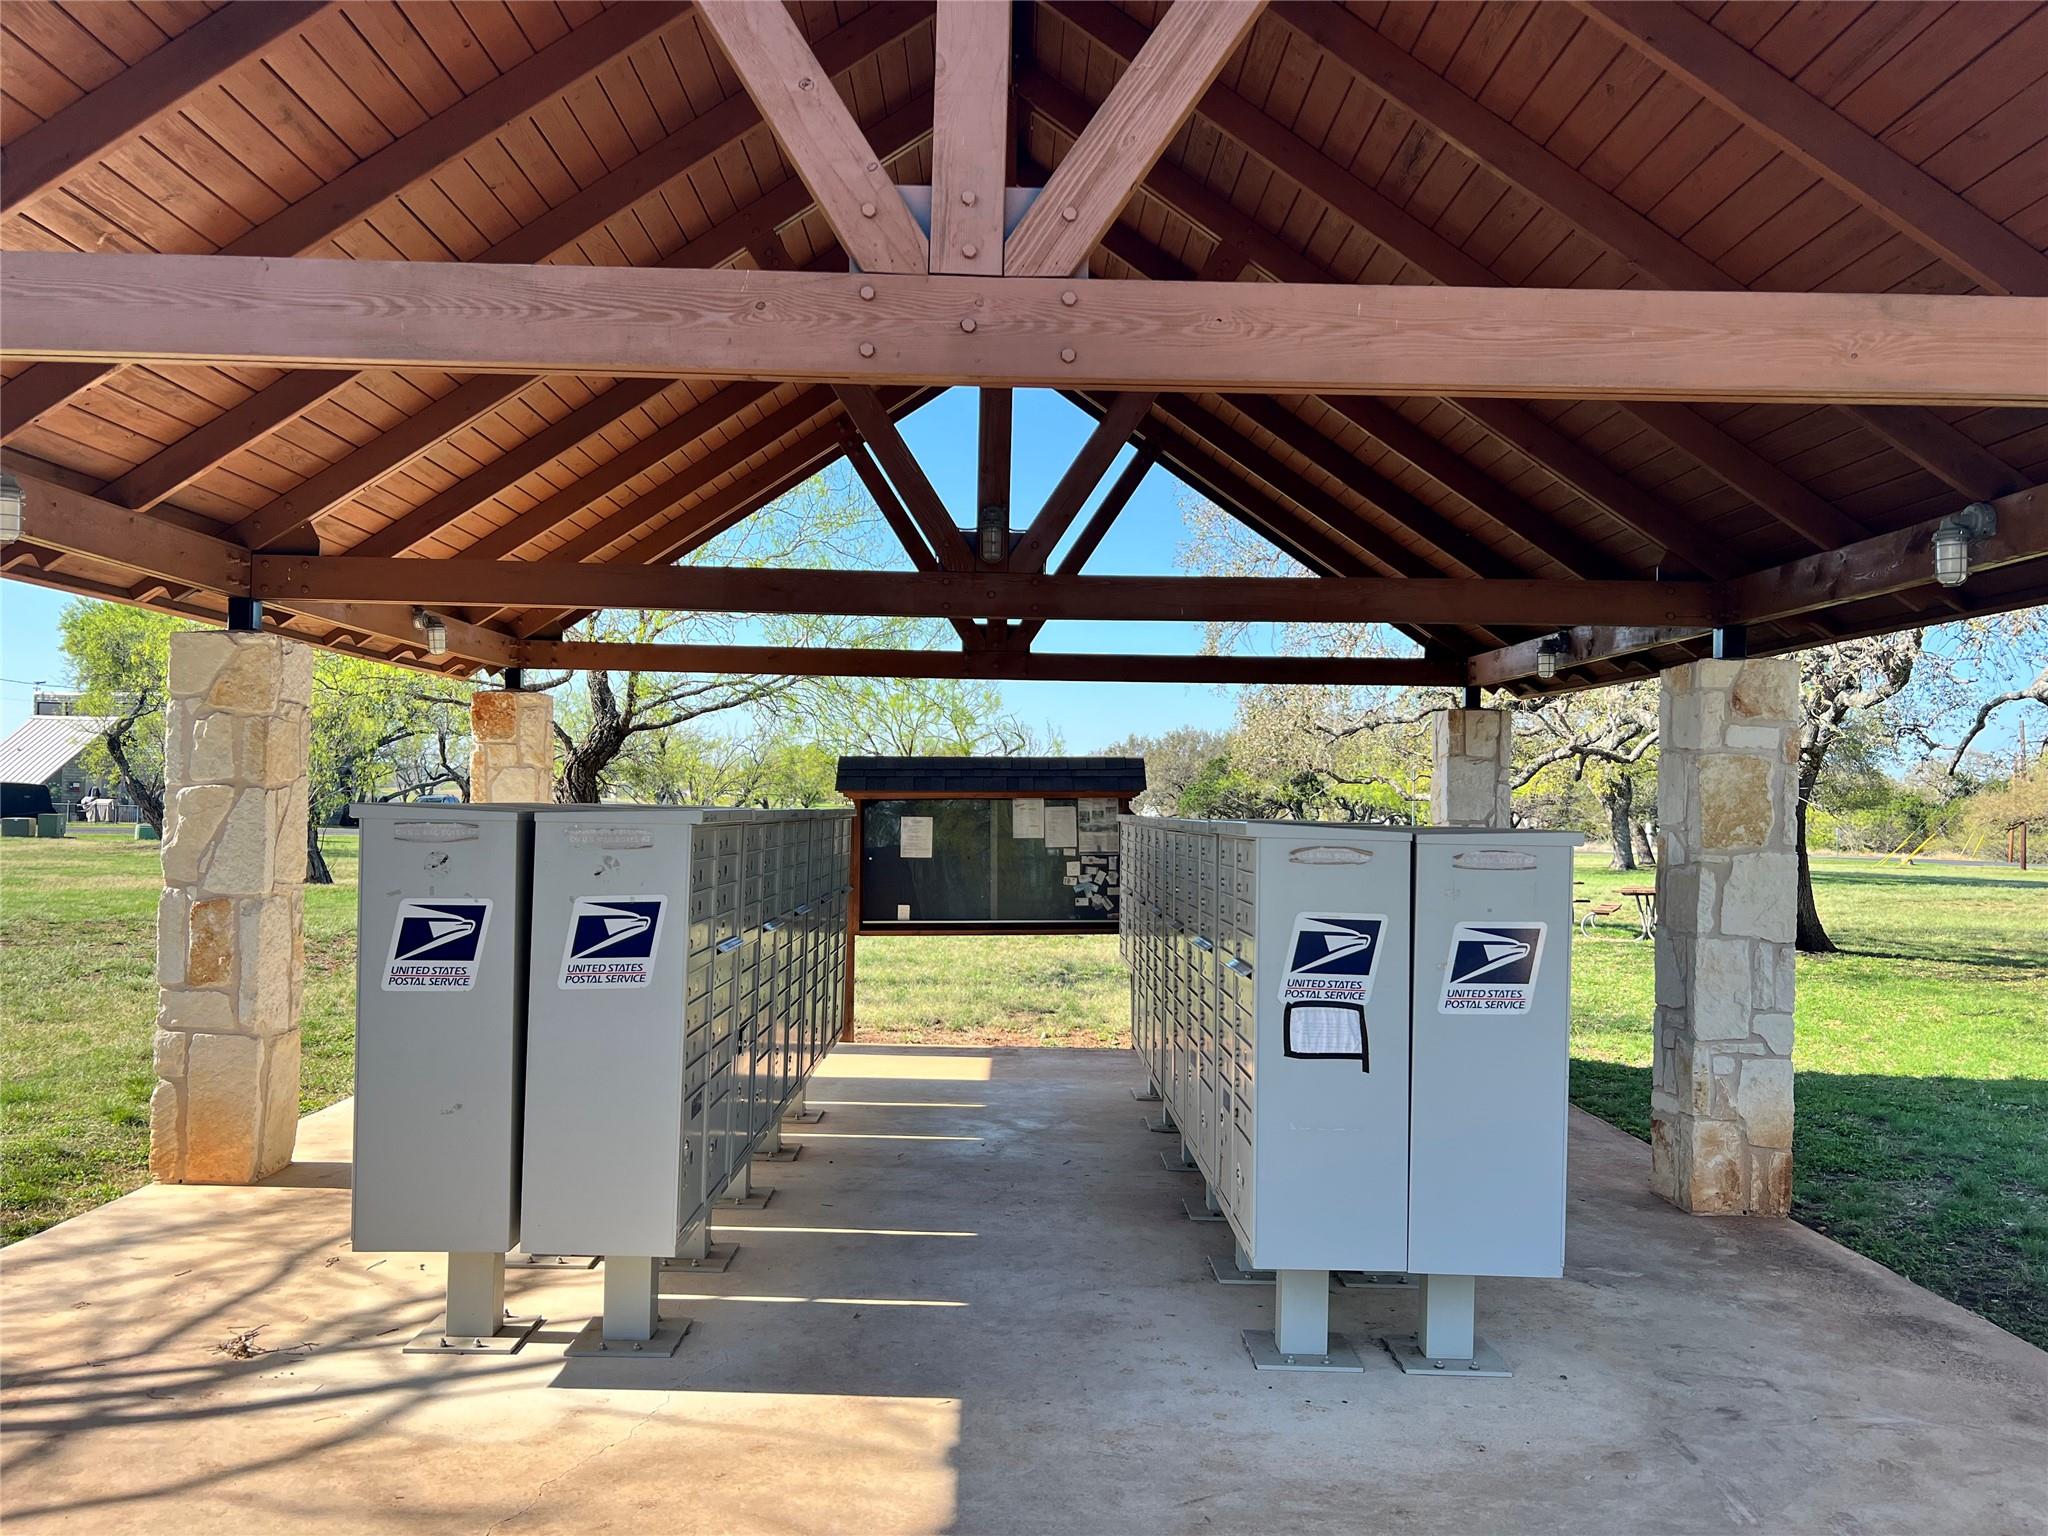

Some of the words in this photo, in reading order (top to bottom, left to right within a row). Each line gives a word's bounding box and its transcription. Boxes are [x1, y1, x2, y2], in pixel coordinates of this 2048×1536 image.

[391, 966, 430, 975] UNITED
[431, 966, 467, 975] STATES
[567, 964, 606, 973] UNITED
[608, 963, 643, 972] STATES
[388, 977, 426, 986] POSTAL
[429, 977, 470, 986] SERVICE
[565, 975, 603, 984] POSTAL
[605, 974, 646, 983] SERVICE
[1287, 979, 1325, 988] UNITED
[1327, 980, 1362, 989] STATES
[1284, 990, 1322, 999] POSTAL
[1324, 991, 1365, 1000] SERVICE
[1447, 989, 1485, 998] UNITED
[1487, 990, 1523, 998] STATES
[1444, 1000, 1482, 1009] POSTAL
[1484, 1000, 1525, 1009] SERVICE
